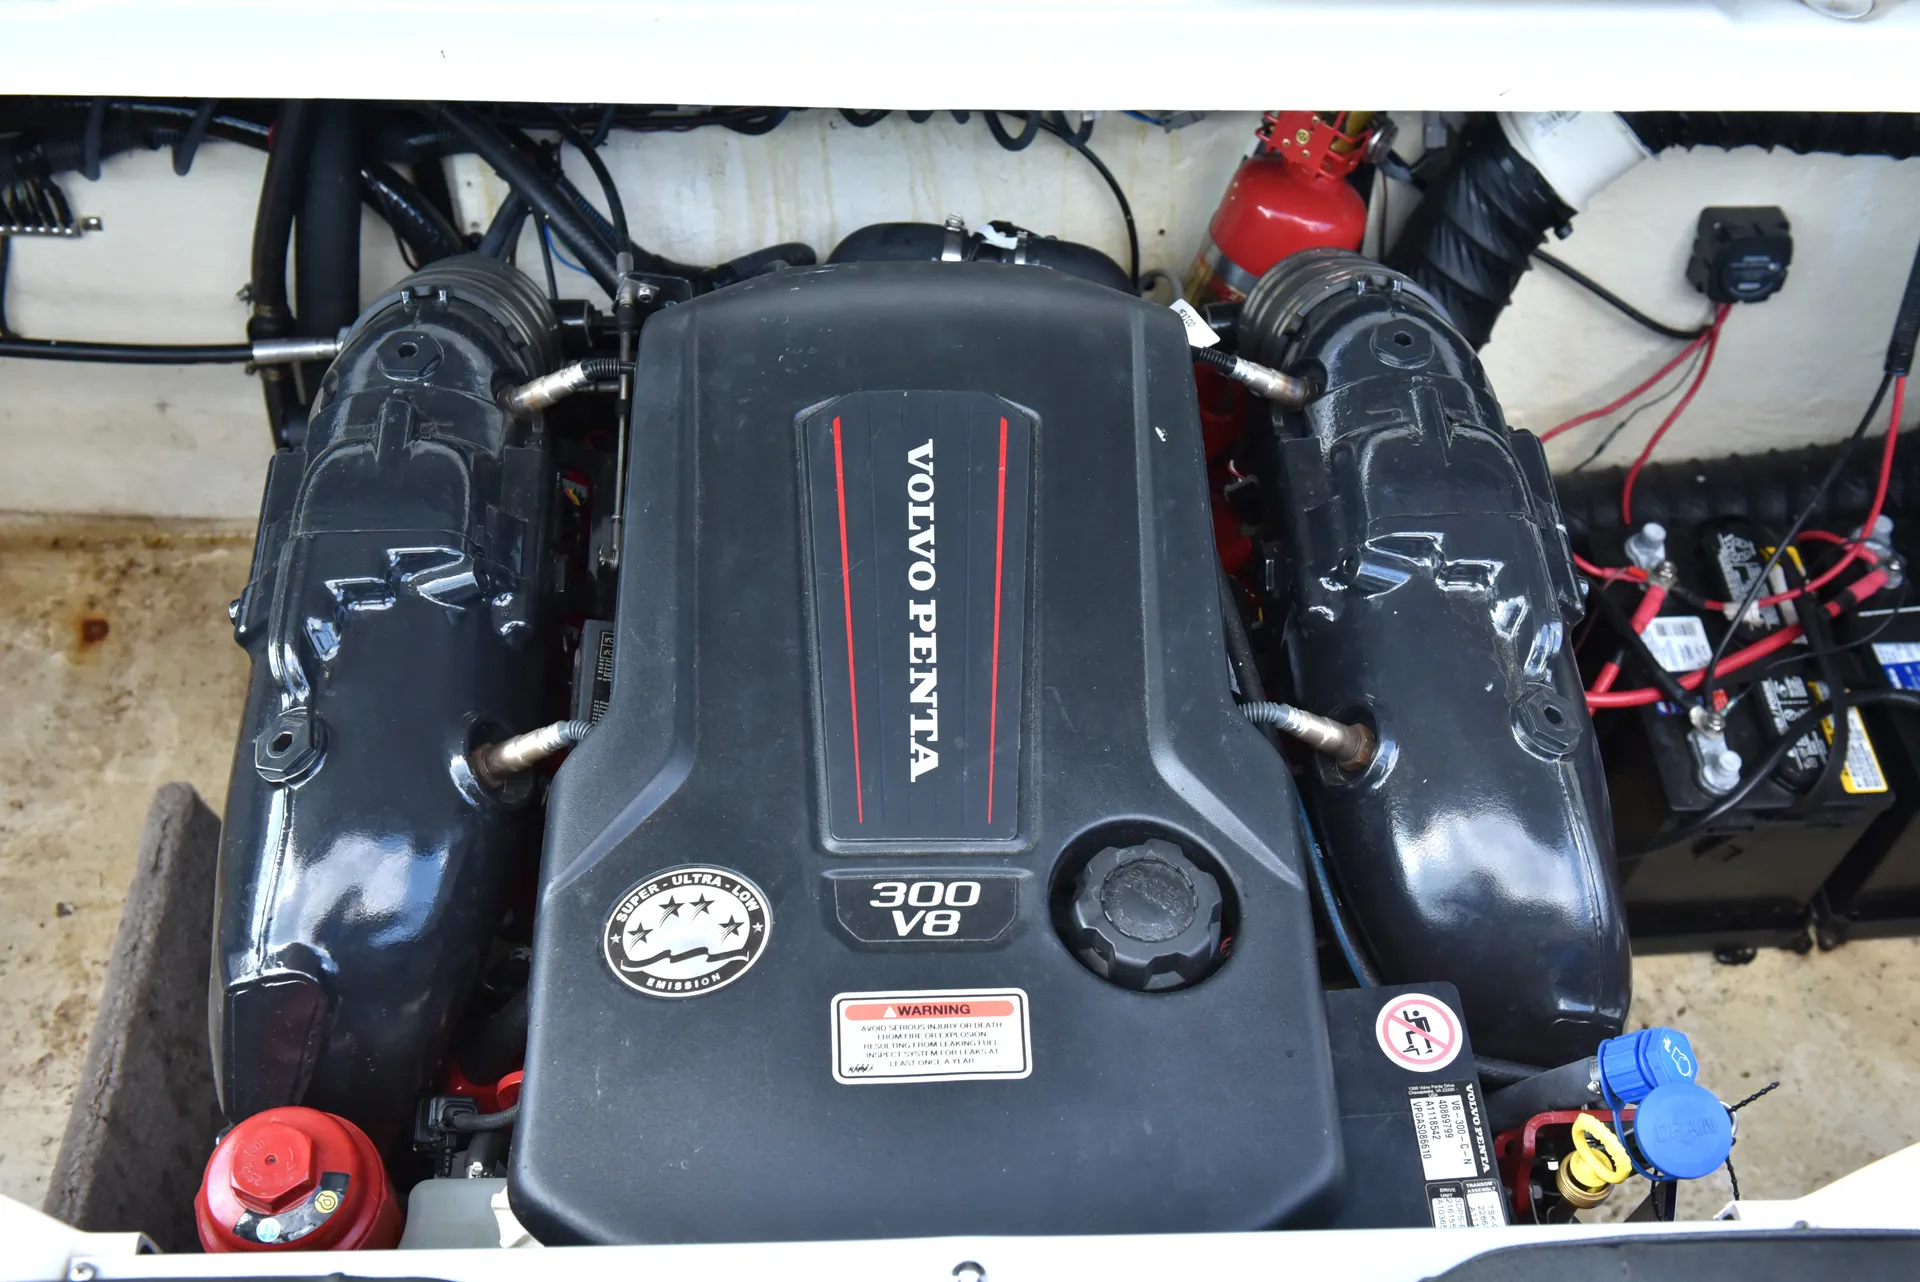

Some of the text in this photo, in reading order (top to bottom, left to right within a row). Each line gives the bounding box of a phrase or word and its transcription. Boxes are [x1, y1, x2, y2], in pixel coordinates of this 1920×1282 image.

[907, 438, 939, 783] VOLVO PENTA
[616, 883, 660, 923] SUPER
[671, 873, 722, 888] ULTRA
[731, 884, 760, 912] LOW
[869, 881, 981, 907] 300
[892, 910, 961, 936] V8
[646, 972, 722, 991] EMISSION
[897, 1004, 971, 1017] WARNING
[1413, 1101, 1432, 1159] VPGAS086610
[1425, 1100, 1441, 1140] A1118542
[1439, 1100, 1454, 1139] 40869799
[1466, 1083, 1490, 1173] VOLVO PENTA
[1655, 1116, 1718, 1143] DRAIN
